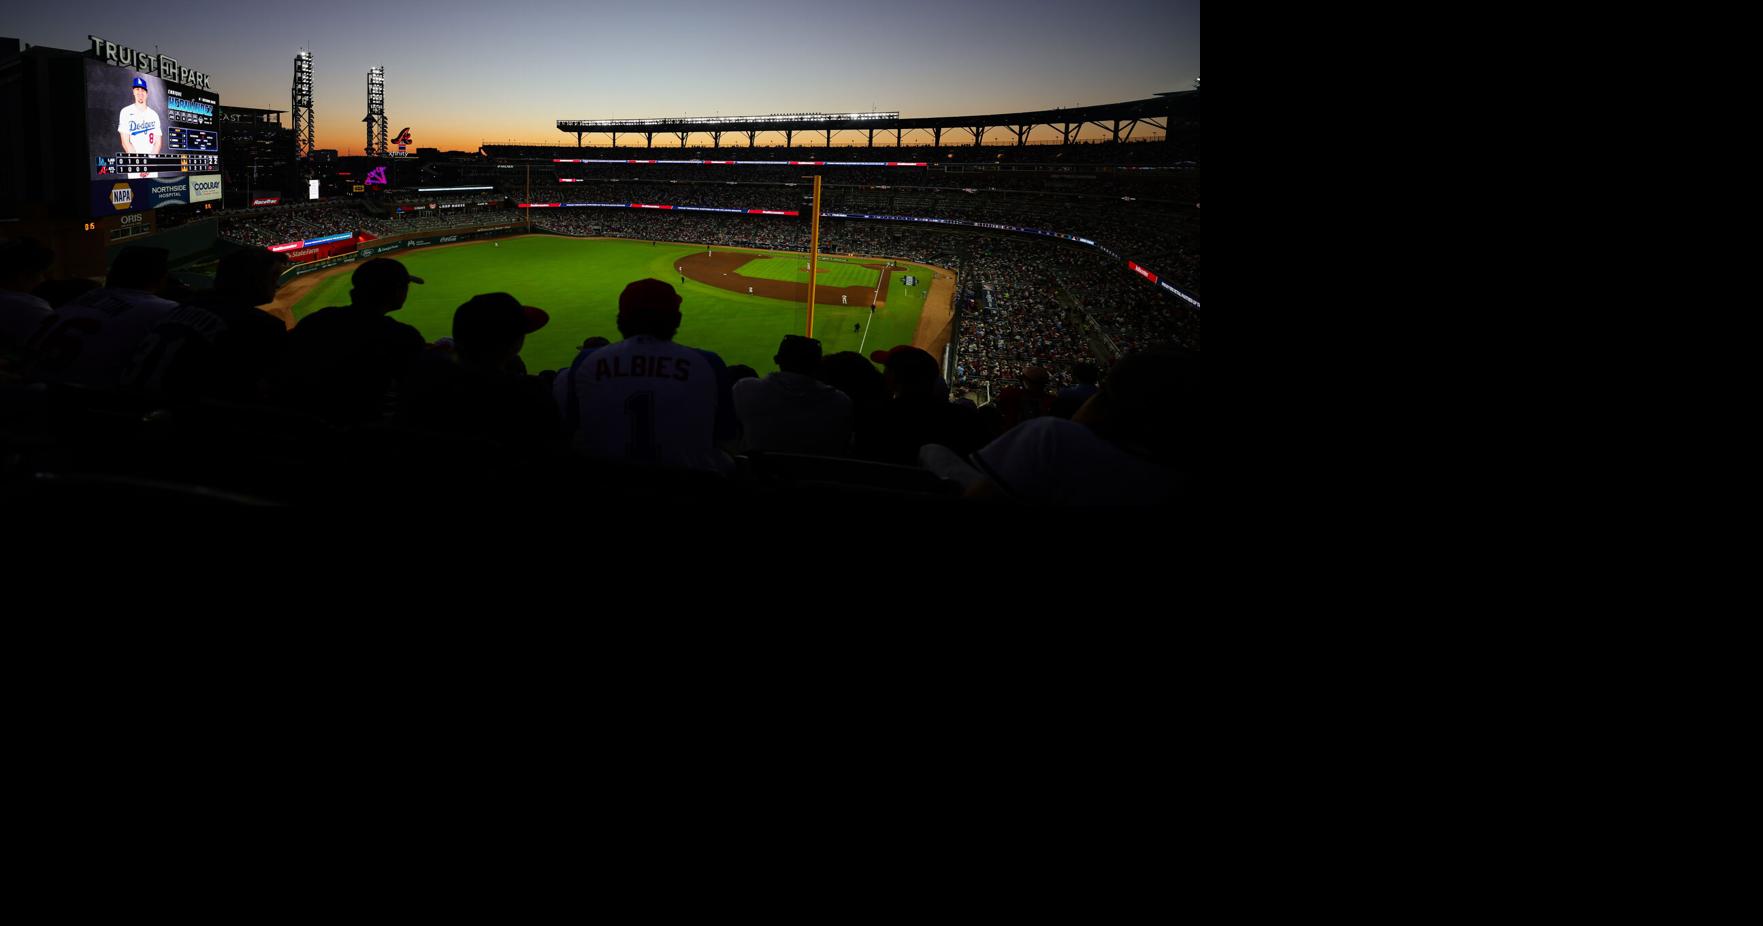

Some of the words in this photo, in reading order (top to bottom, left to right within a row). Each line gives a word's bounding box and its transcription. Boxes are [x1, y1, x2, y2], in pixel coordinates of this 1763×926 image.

[91, 36, 157, 72] TRUIST
[181, 67, 211, 89] PARK
[148, 132, 154, 145] 8
[152, 184, 187, 194] NORTHSIDE
[194, 181, 220, 191] COOLRAY
[113, 190, 132, 203] NAPA
[121, 213, 143, 224] ORIS
[596, 355, 690, 382] ALBIES
[624, 390, 662, 461] 1
